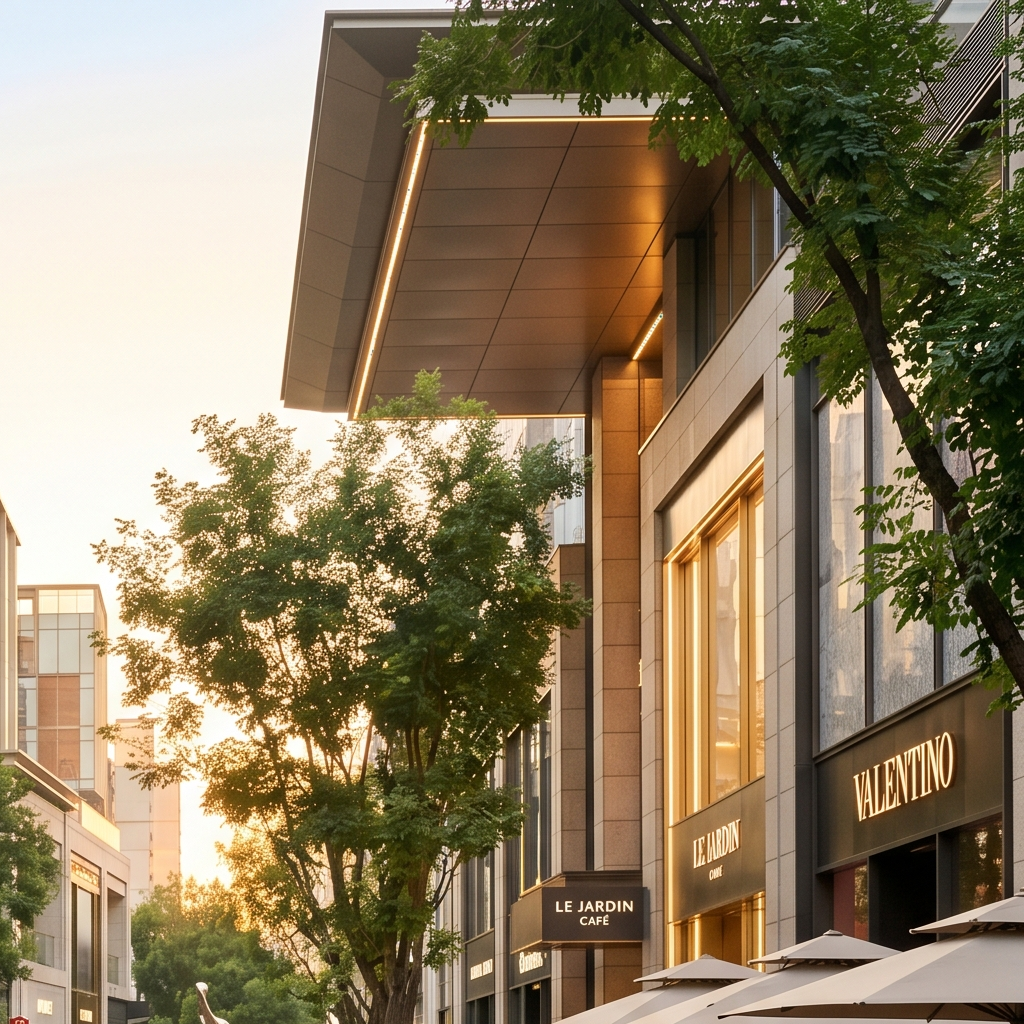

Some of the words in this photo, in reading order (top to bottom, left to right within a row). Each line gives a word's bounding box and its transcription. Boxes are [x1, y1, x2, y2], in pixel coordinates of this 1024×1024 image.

[853, 731, 954, 822] VALENTINO
[555, 900, 573, 913] LE
[577, 900, 634, 913] JARDIN
[579, 914, 610, 926] CAFÉ
